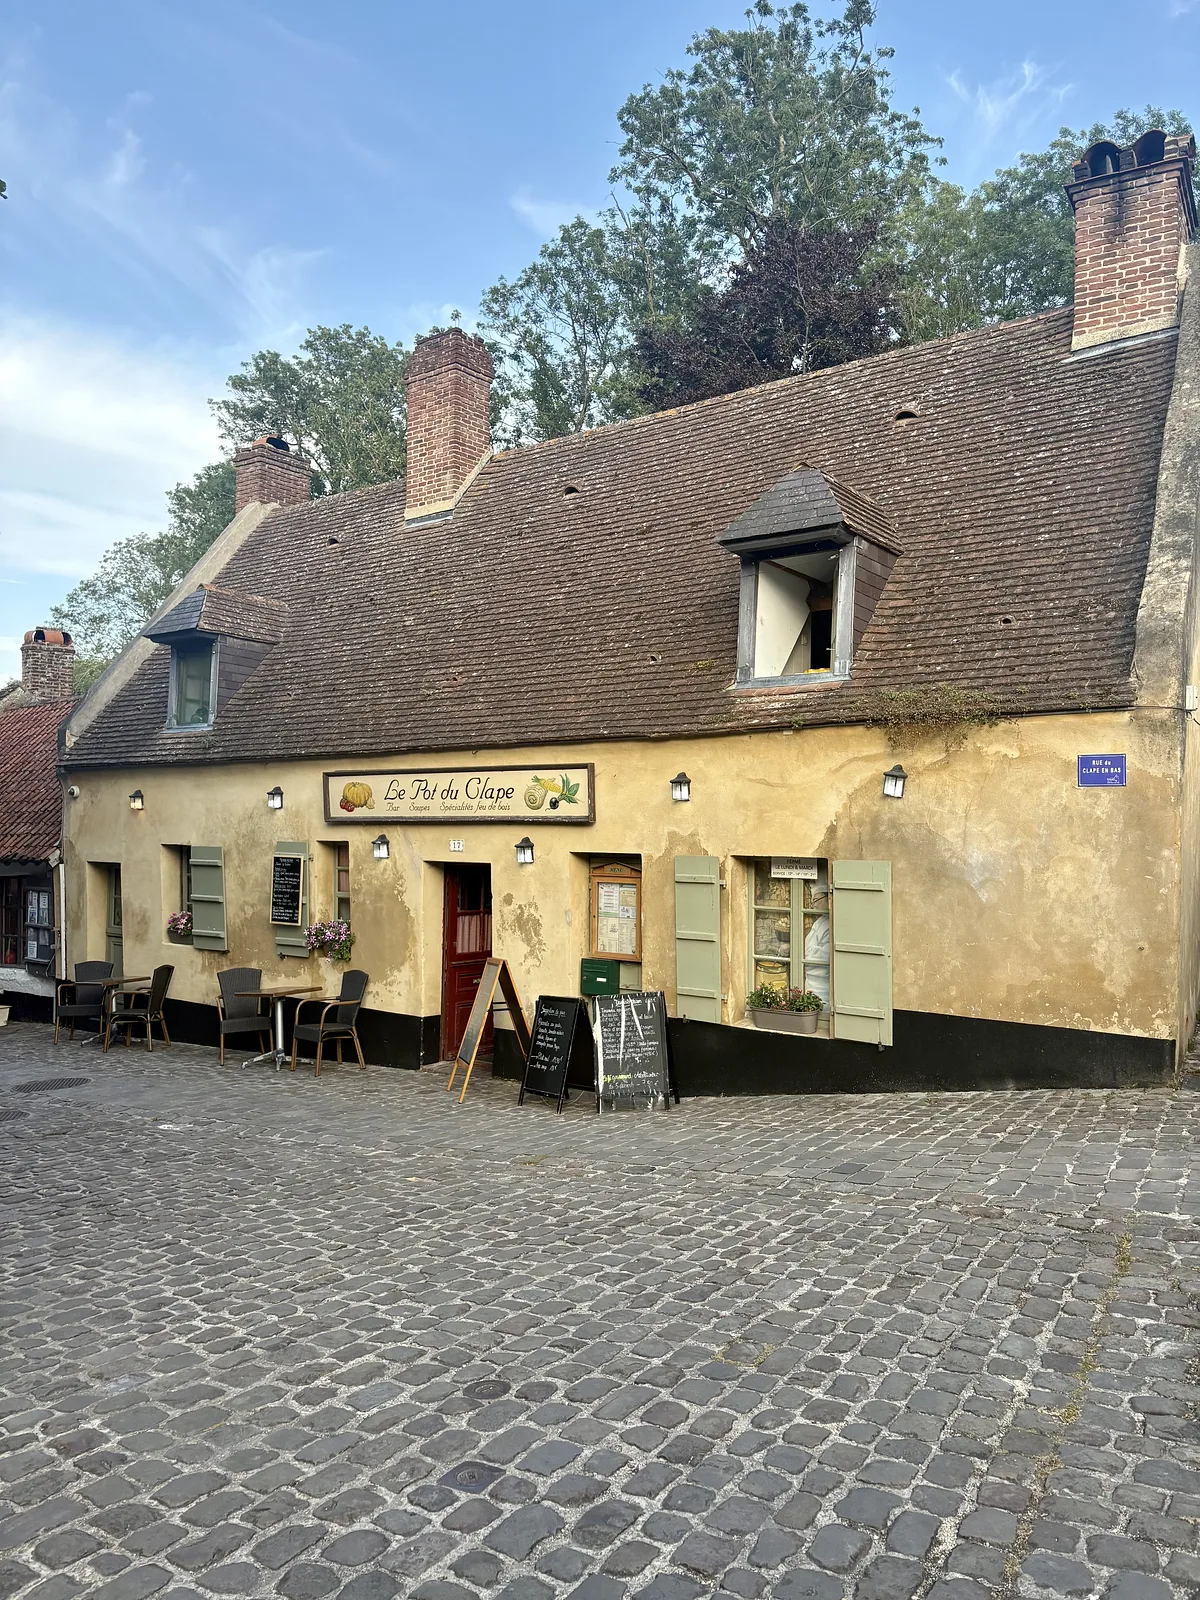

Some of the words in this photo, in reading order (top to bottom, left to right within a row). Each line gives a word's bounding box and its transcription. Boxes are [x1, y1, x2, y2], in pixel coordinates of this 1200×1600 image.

[384, 779, 406, 800] Le
[409, 778, 438, 800] Pot
[440, 778, 459, 800] du
[465, 777, 515, 804] Clape
[386, 802, 400, 812] Bar
[409, 801, 430, 814] Soupes
[439, 801, 473, 814] Spécialités
[474, 801, 487, 814] feu
[487, 801, 497, 811] de
[498, 801, 511, 811] bois
